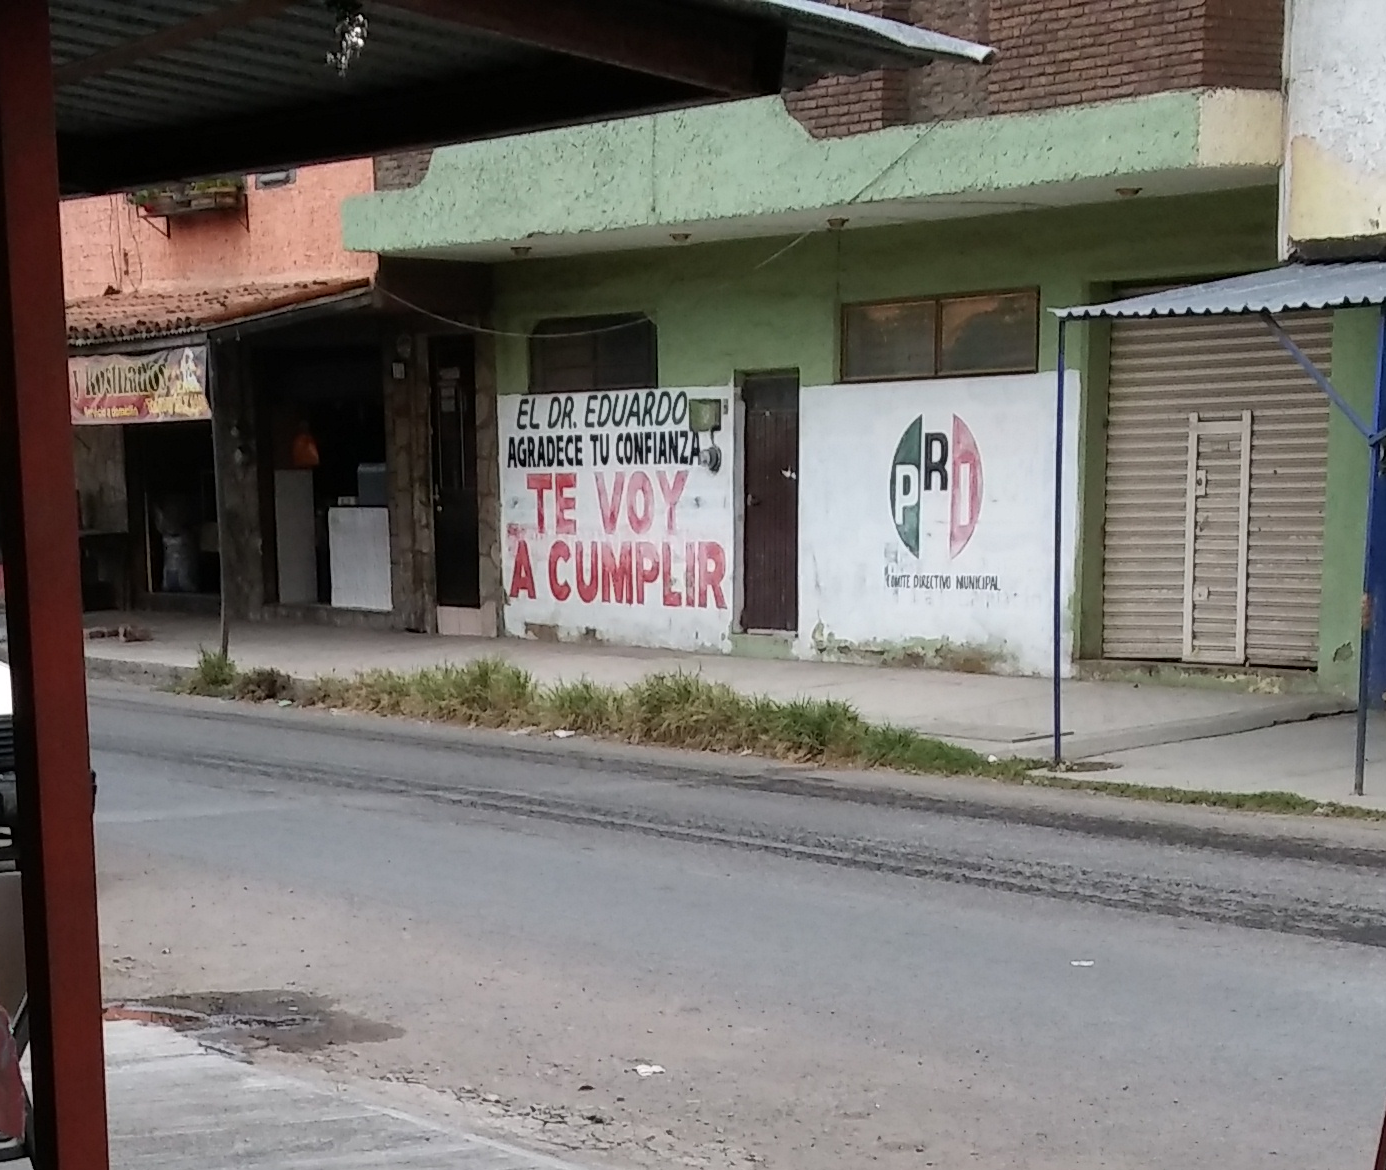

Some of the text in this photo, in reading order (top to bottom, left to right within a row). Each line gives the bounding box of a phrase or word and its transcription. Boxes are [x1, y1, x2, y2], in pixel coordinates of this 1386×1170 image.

[516, 390, 689, 430] EL DR. EDUARDO
[507, 430, 701, 468] AGRADECE TU CONFIANZA
[526, 469, 690, 536] TE VOY
[894, 432, 971, 527] PRI
[509, 540, 728, 610] A CUMPLIR
[885, 573, 1001, 592] COMITE DIRECTIVO MUNICIPAL
